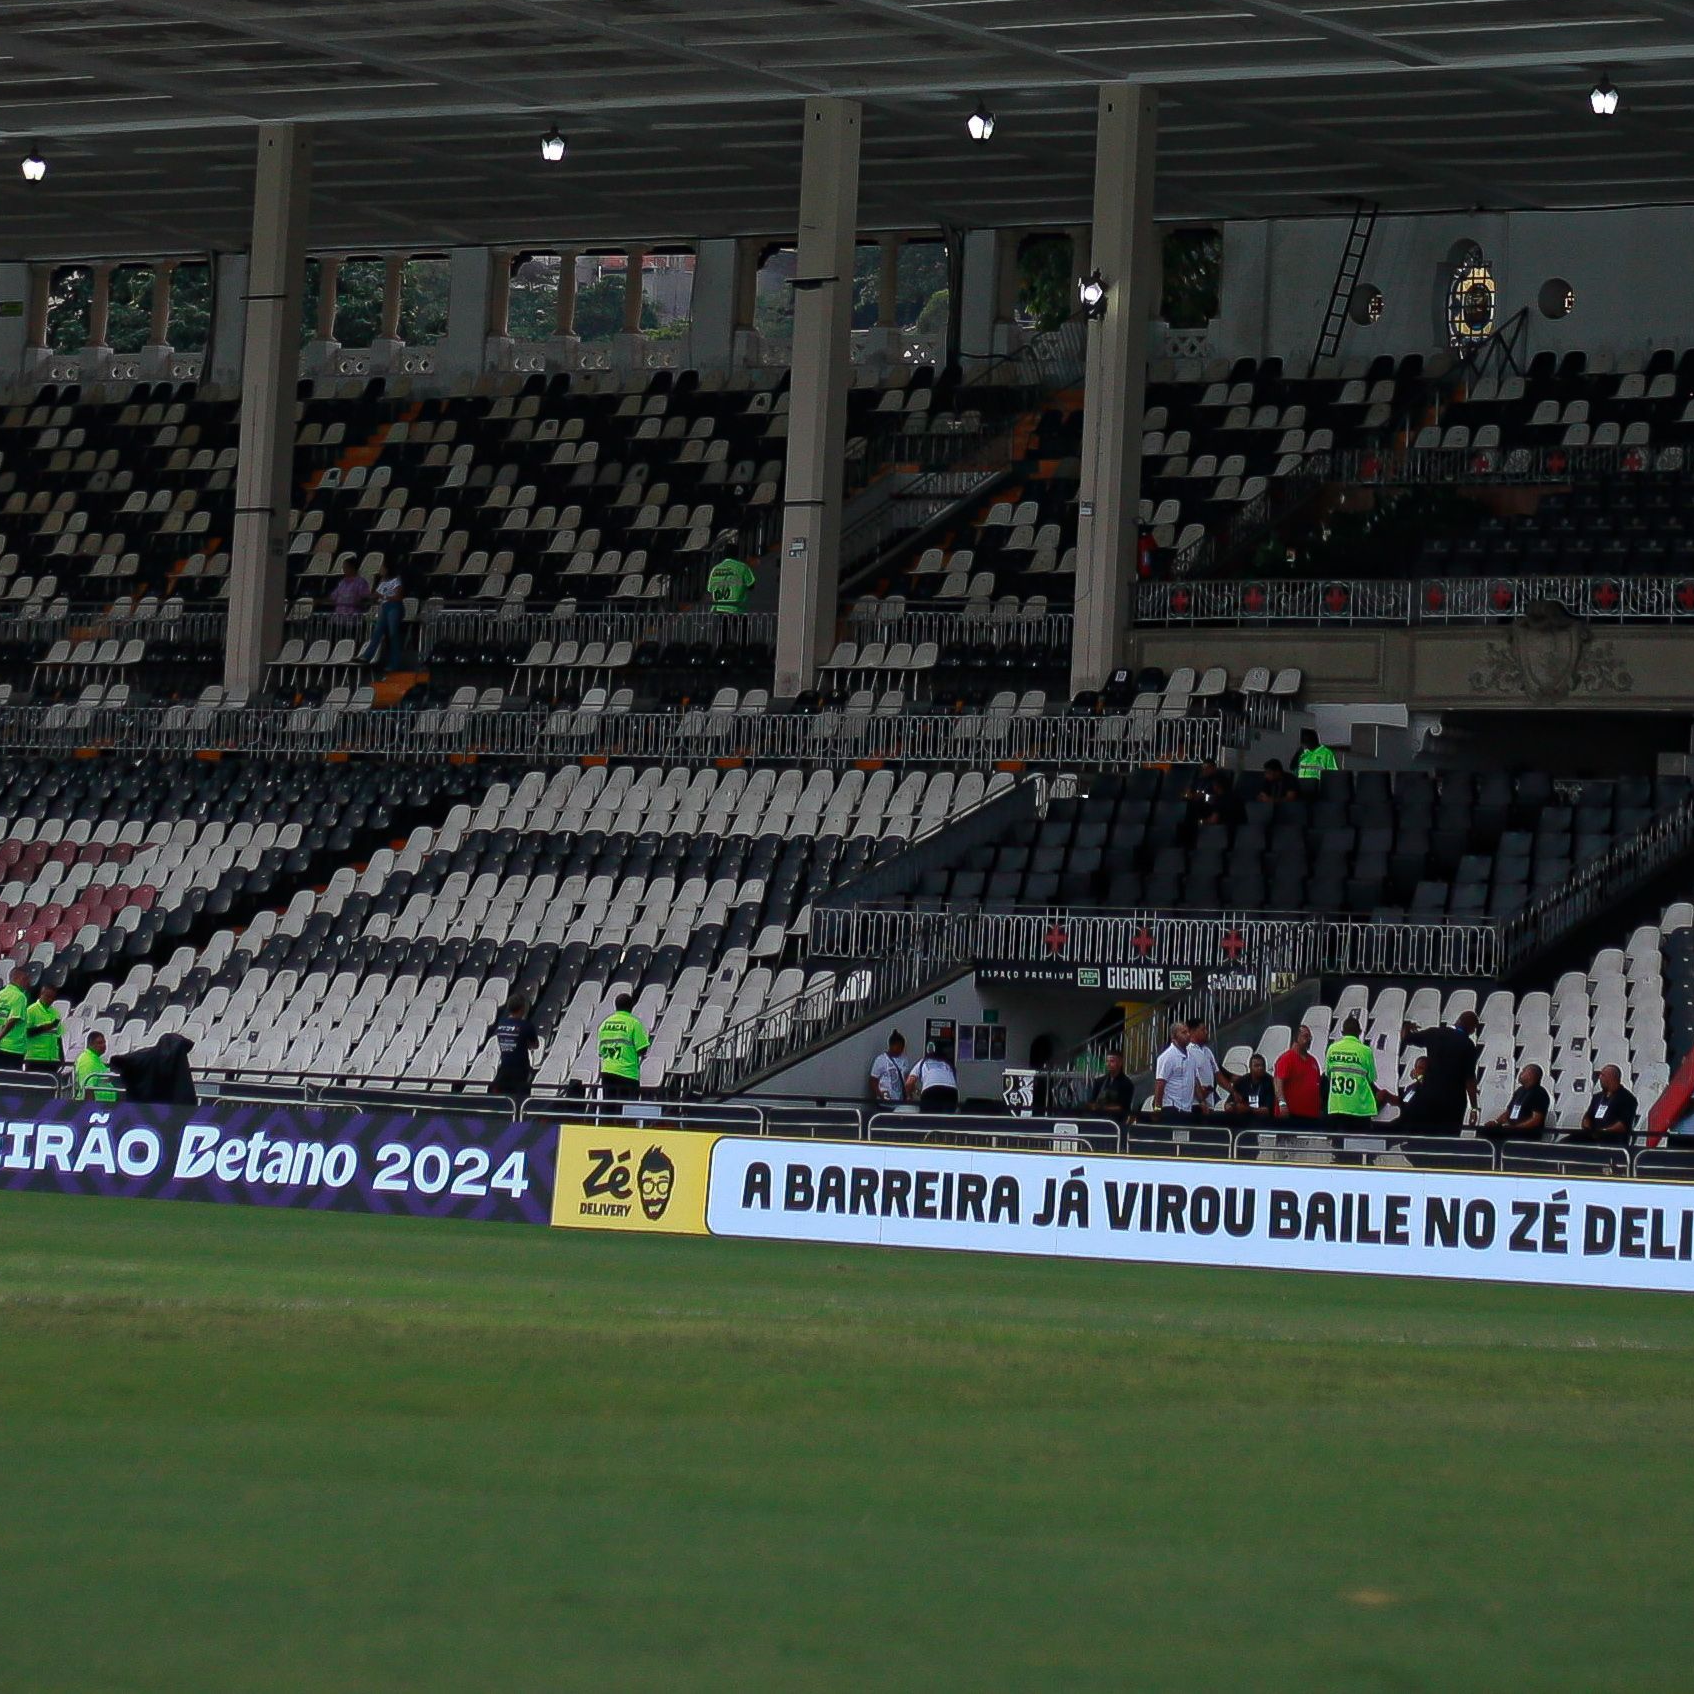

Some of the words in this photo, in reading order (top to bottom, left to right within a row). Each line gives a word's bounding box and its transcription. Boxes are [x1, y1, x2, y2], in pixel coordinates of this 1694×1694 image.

[1025, 970, 1074, 980] PREMIUM
[1107, 967, 1164, 991] GIGANTE
[173, 1125, 357, 1188] Betano
[372, 1142, 529, 1199] 2024
[582, 1148, 634, 1200] Zé
[579, 1202, 632, 1217] DELIVERY
[741, 1161, 773, 1211] A
[783, 1163, 1021, 1225] BARREIRA
[1031, 1165, 1090, 1228] JÁ
[1104, 1180, 1257, 1238] VIROU
[1267, 1189, 1413, 1247] BAILE
[1423, 1195, 1497, 1251] NO
[1508, 1188, 1571, 1255] ZÉ
